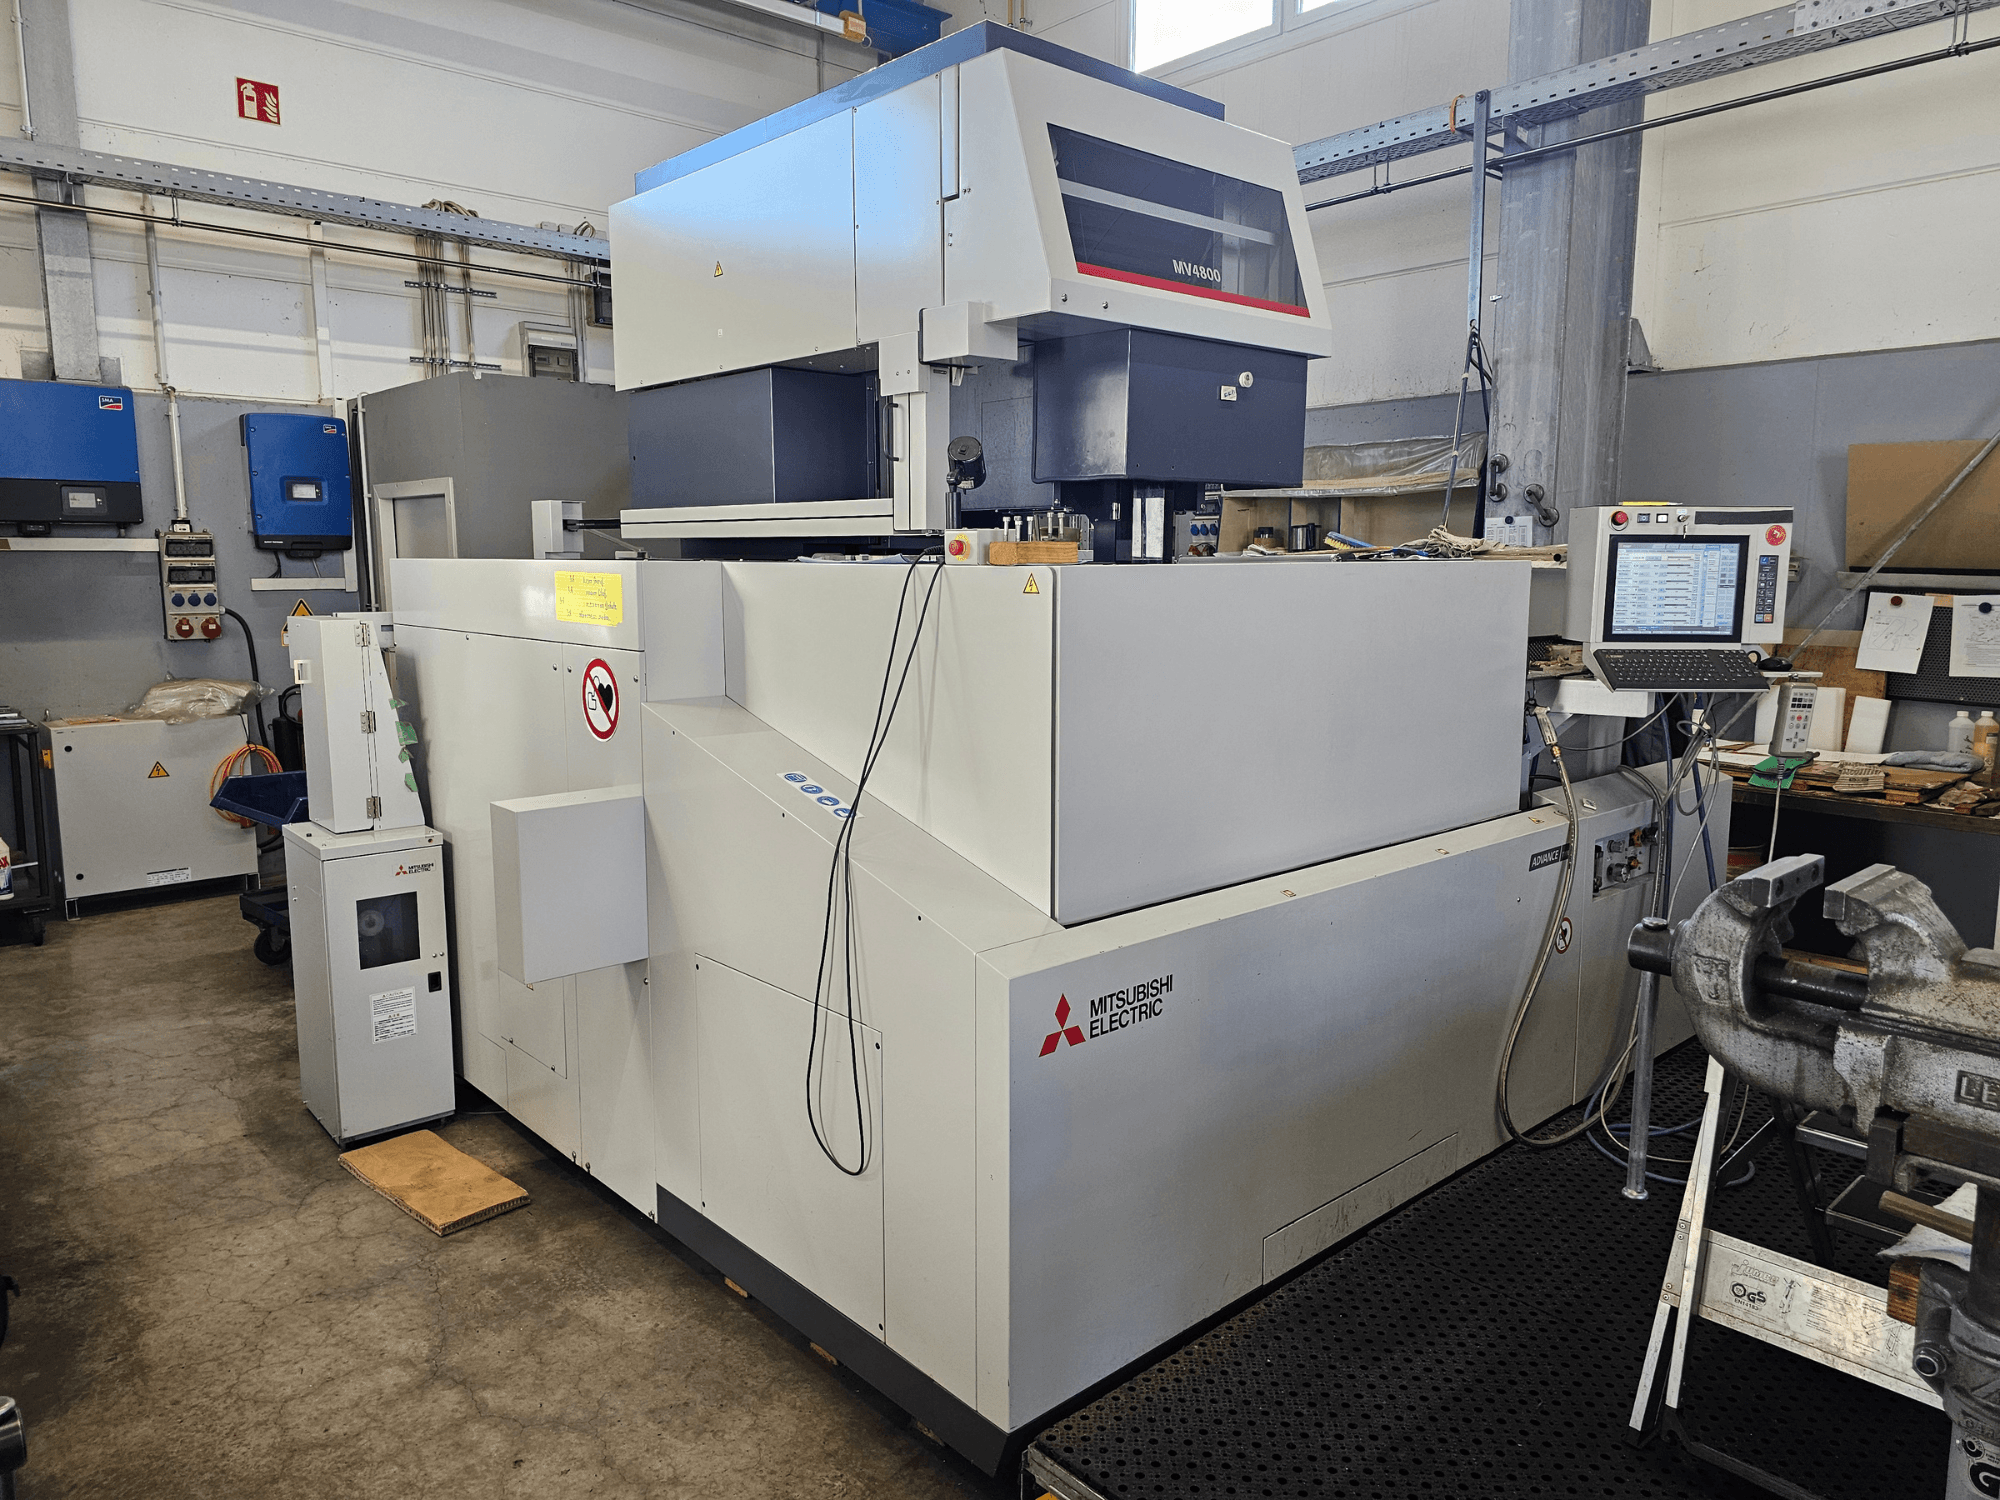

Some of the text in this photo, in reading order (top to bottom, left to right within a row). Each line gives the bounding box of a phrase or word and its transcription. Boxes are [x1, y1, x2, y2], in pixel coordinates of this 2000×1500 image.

[1172, 259, 1221, 283] MV4800
[1531, 850, 1559, 868] ADVANCE
[1090, 974, 1173, 1018] MITSUBISHI
[1089, 998, 1163, 1039] ELECTRIC
[1747, 1291, 1767, 1304] GS
